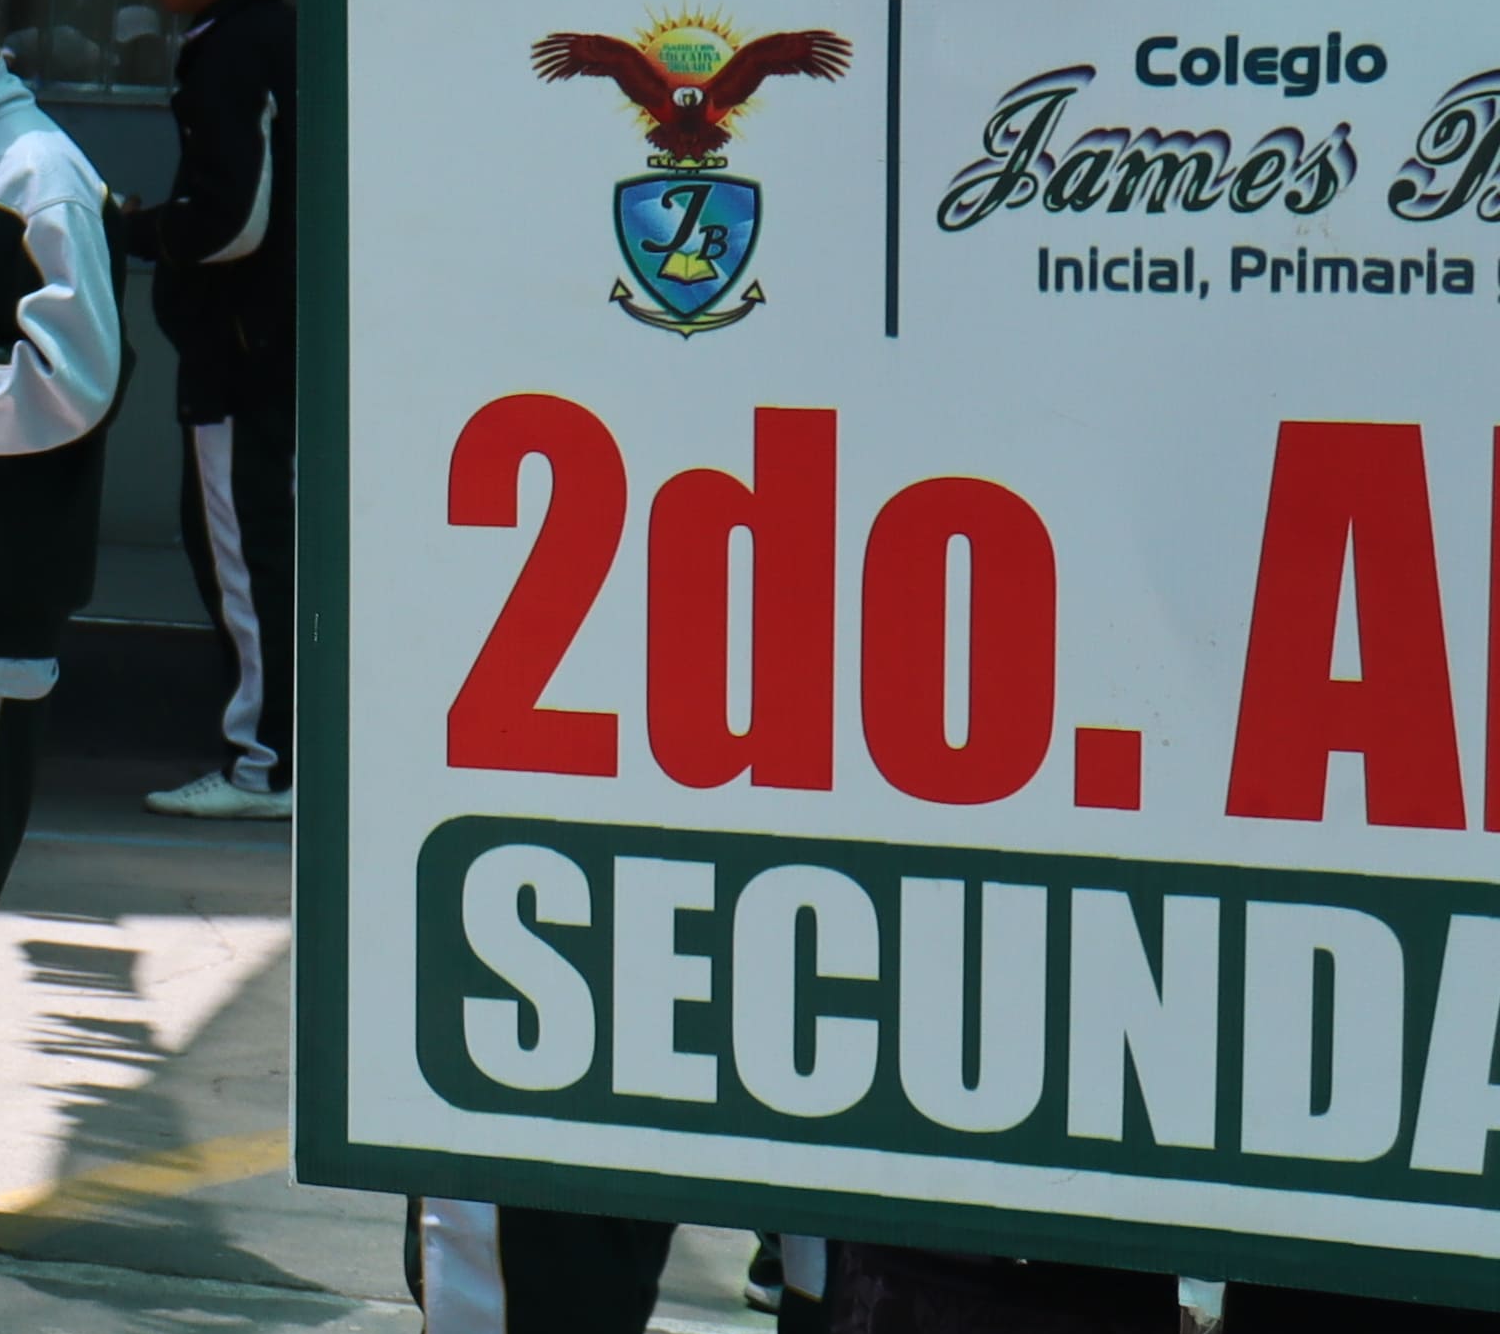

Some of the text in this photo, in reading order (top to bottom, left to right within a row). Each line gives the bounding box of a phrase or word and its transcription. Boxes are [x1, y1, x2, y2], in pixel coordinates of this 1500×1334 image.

[1135, 32, 1388, 97] Colegio
[936, 64, 1358, 233] James
[1038, 246, 1475, 300] Inicial, Primaria
[446, 393, 1500, 833] 2do. A
